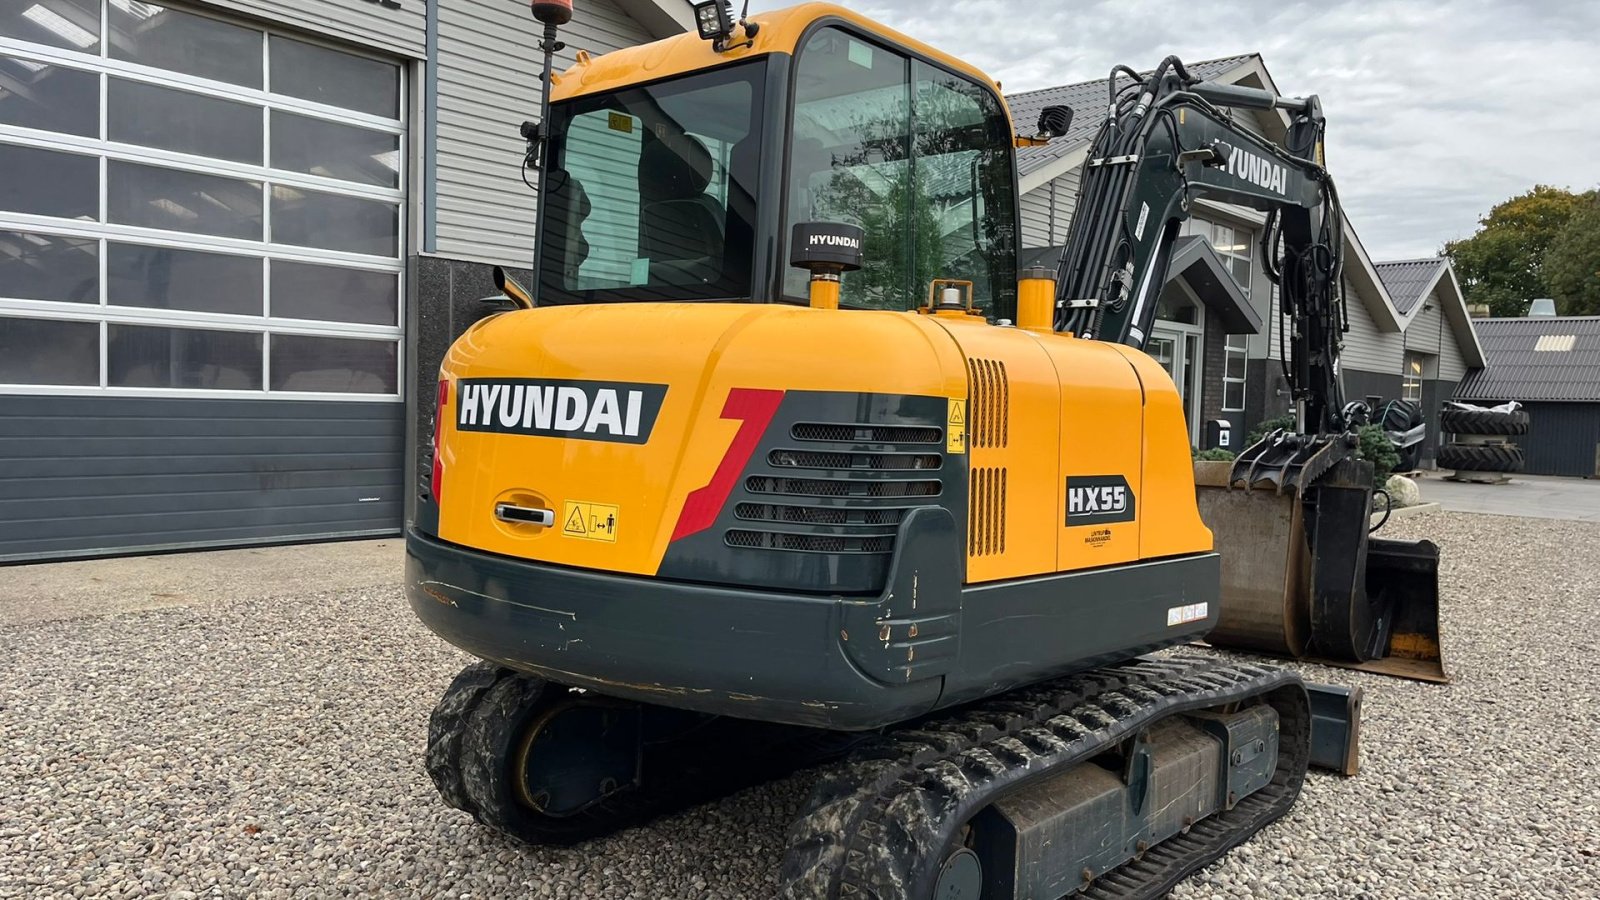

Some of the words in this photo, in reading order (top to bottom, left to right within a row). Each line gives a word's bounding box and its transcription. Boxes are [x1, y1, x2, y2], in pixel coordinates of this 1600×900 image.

[1212, 138, 1287, 196] YUNDAI
[809, 235, 859, 249] HYUNDAI
[460, 384, 643, 437] HYUNDAI
[1068, 486, 1126, 513] HX55
